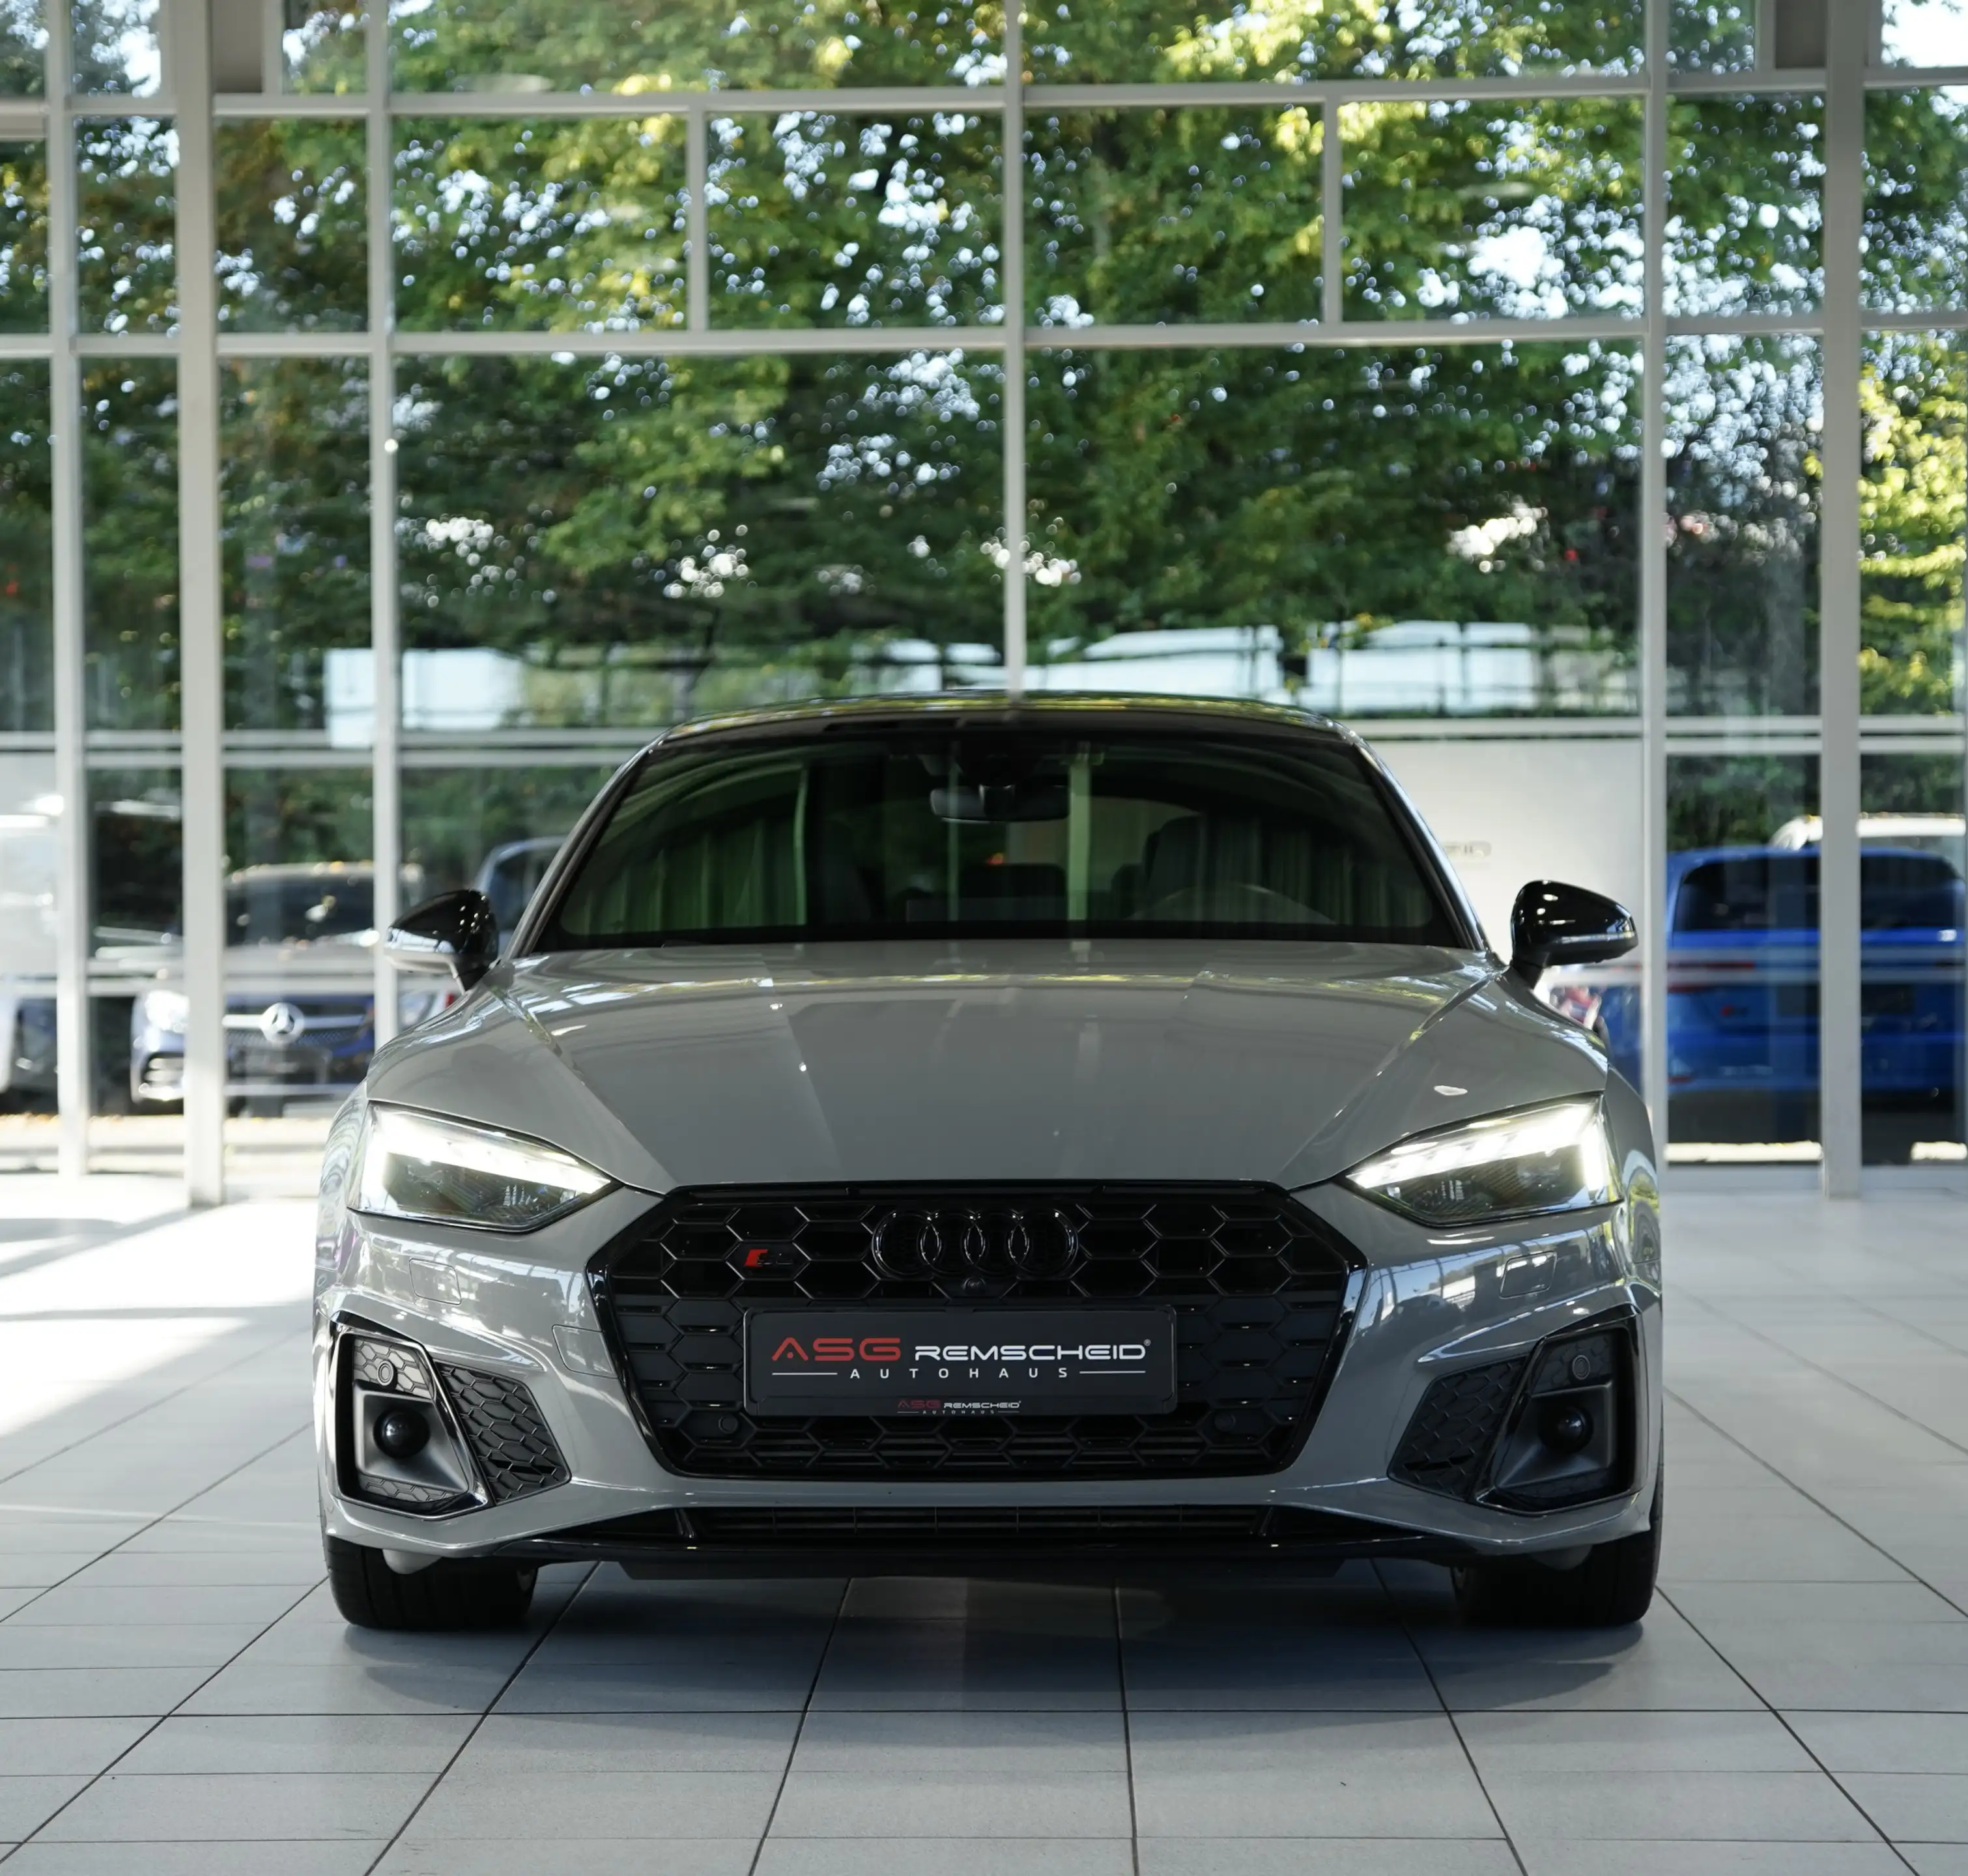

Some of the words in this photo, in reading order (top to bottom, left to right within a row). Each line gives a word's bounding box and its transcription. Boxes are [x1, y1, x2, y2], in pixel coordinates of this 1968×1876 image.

[771, 1337, 900, 1361] ASG
[849, 1367, 1068, 1379] AUTOHAUS
[898, 1399, 941, 1409] ASG
